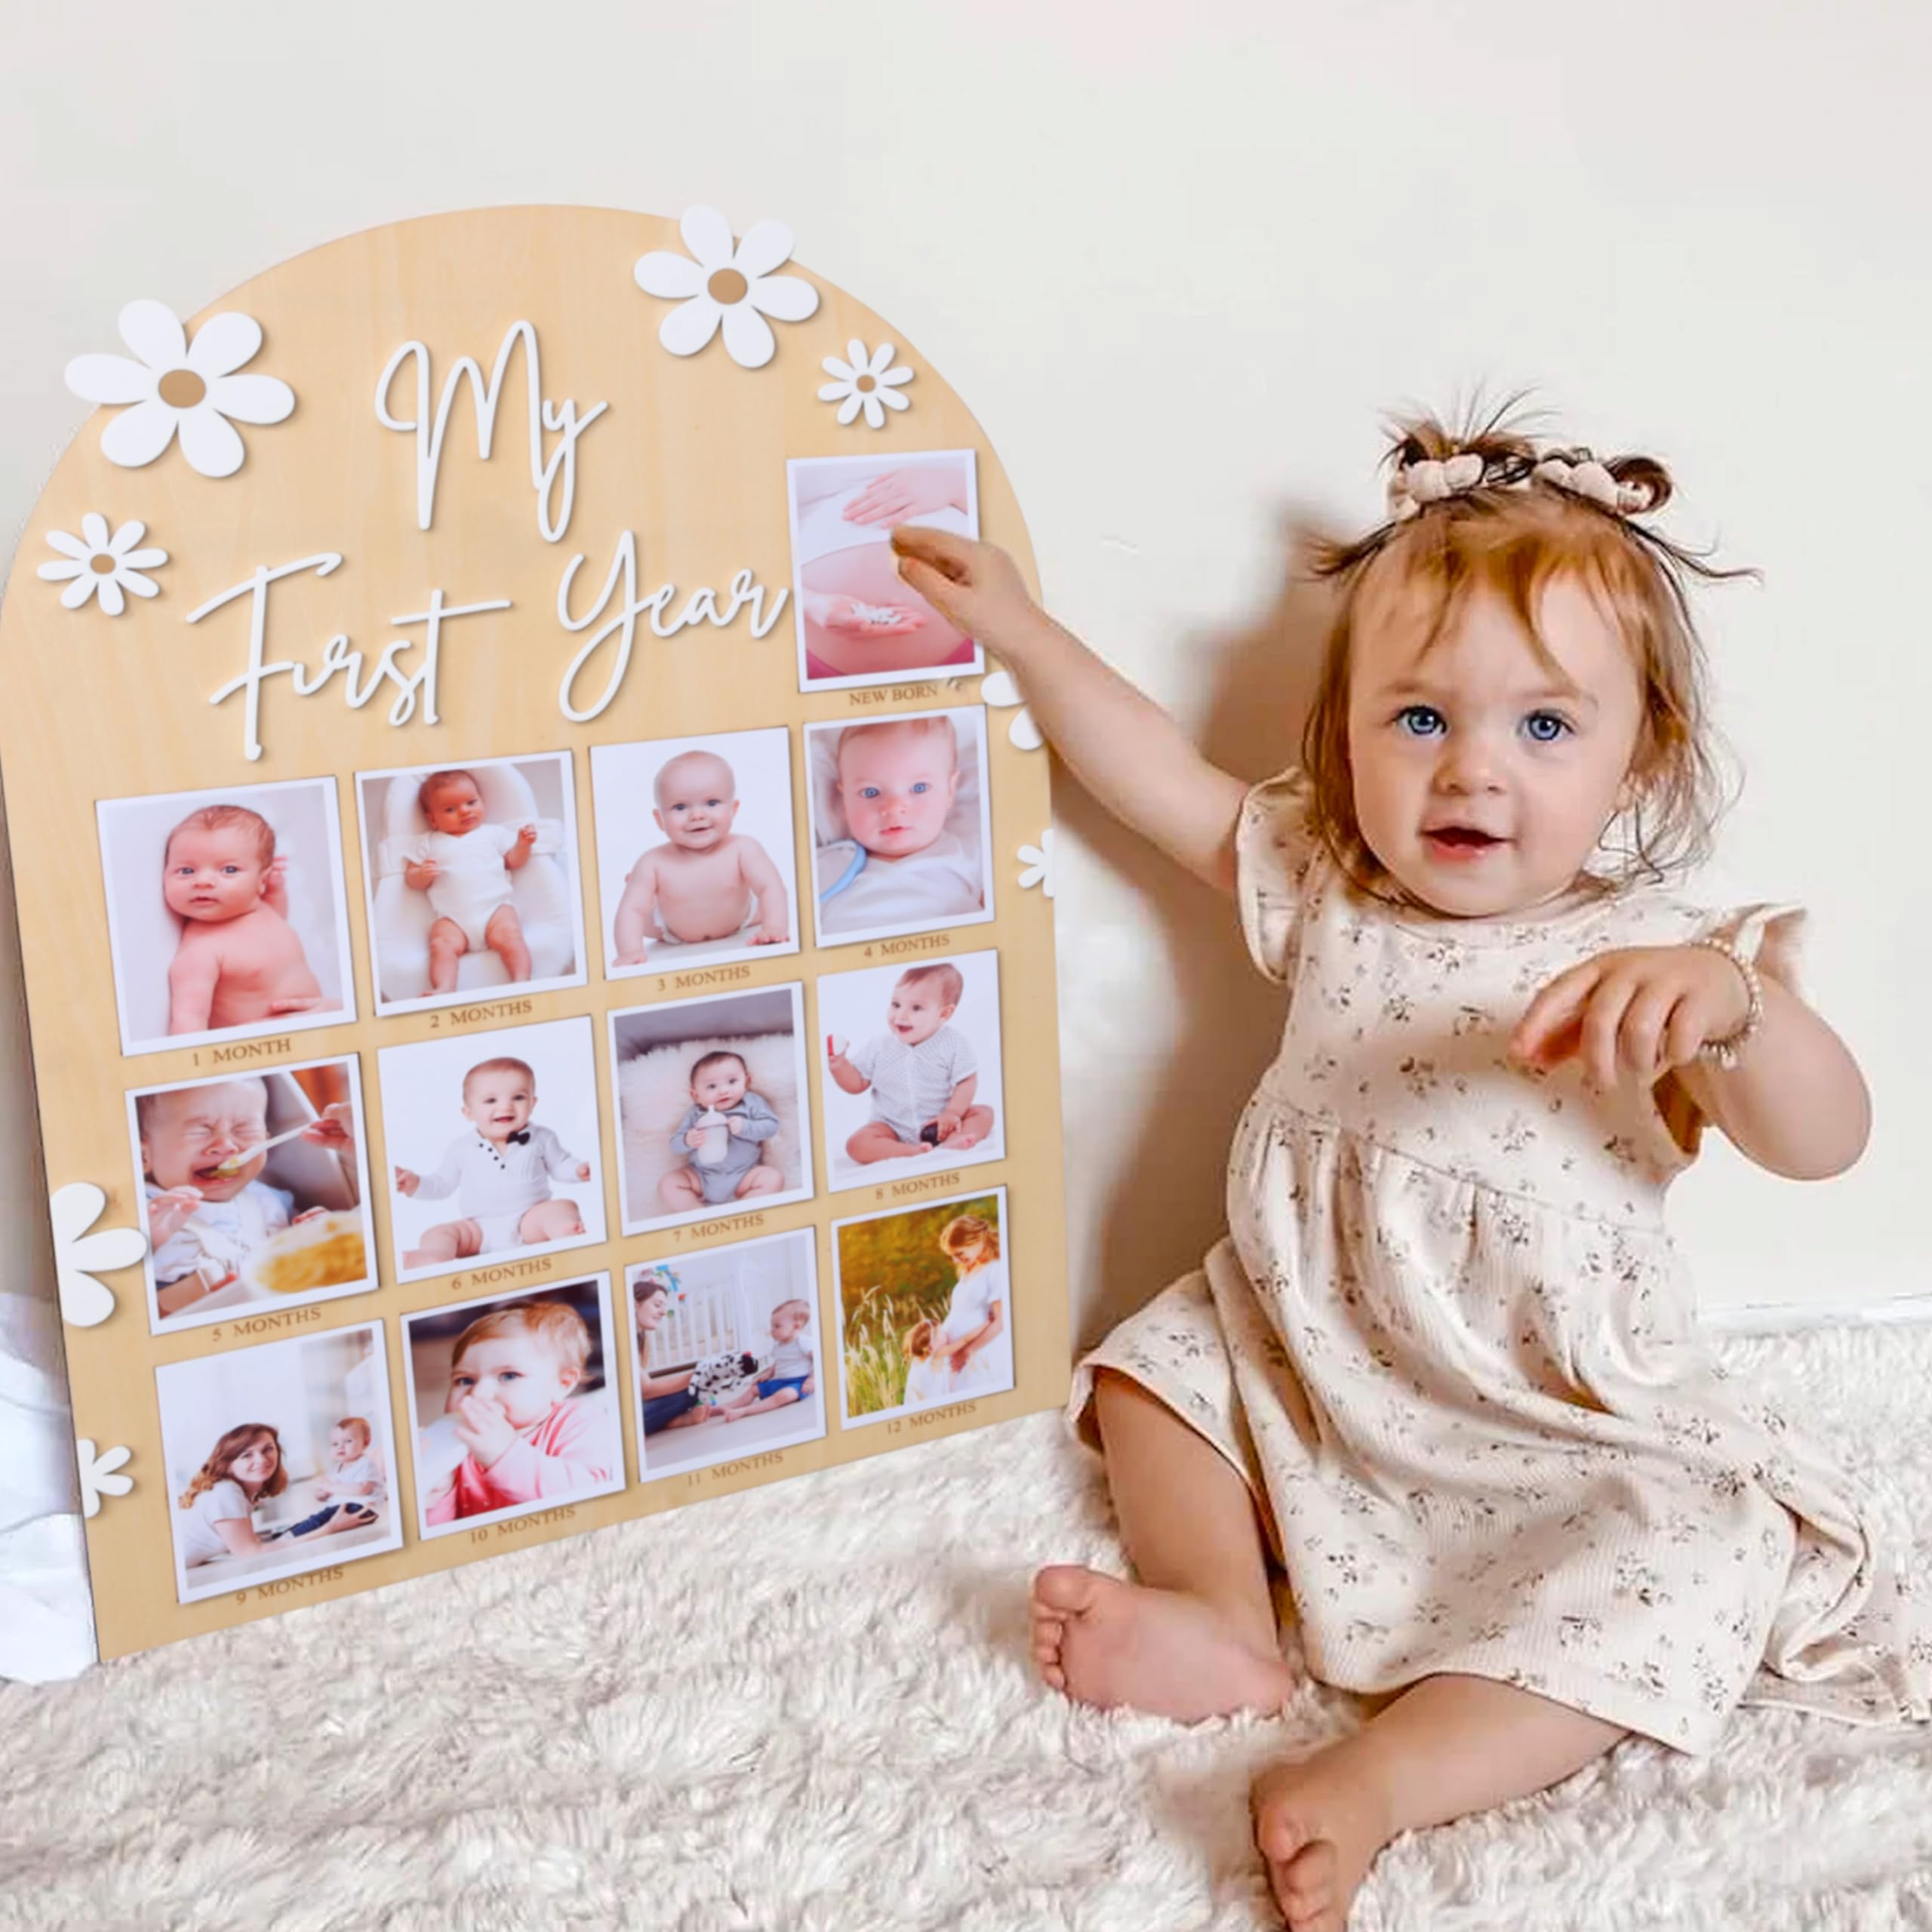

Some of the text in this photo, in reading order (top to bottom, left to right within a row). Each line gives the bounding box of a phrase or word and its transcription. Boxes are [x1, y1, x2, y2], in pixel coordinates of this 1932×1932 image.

[375, 321, 608, 543] My
[186, 530, 789, 761] First Year
[849, 685, 939, 706] NEW BORN
[864, 934, 951, 957] 4 MONTHS
[658, 965, 751, 992] 3 MONTHS
[429, 999, 533, 1028] 2 MONTHS
[193, 1038, 292, 1066] 1 MONTH
[876, 1172, 961, 1200] 8 MONTHS
[674, 1213, 765, 1242] 7 MONTHS
[451, 1257, 552, 1290] 6 MONTHS
[212, 1306, 322, 1341] 5 MONTHS
[887, 1401, 977, 1435] 12 MONTHS
[688, 1451, 784, 1486] 11 MONTHS
[470, 1504, 577, 1544] 10 MONTHS
[235, 1565, 344, 1605] 9 MONTHS
